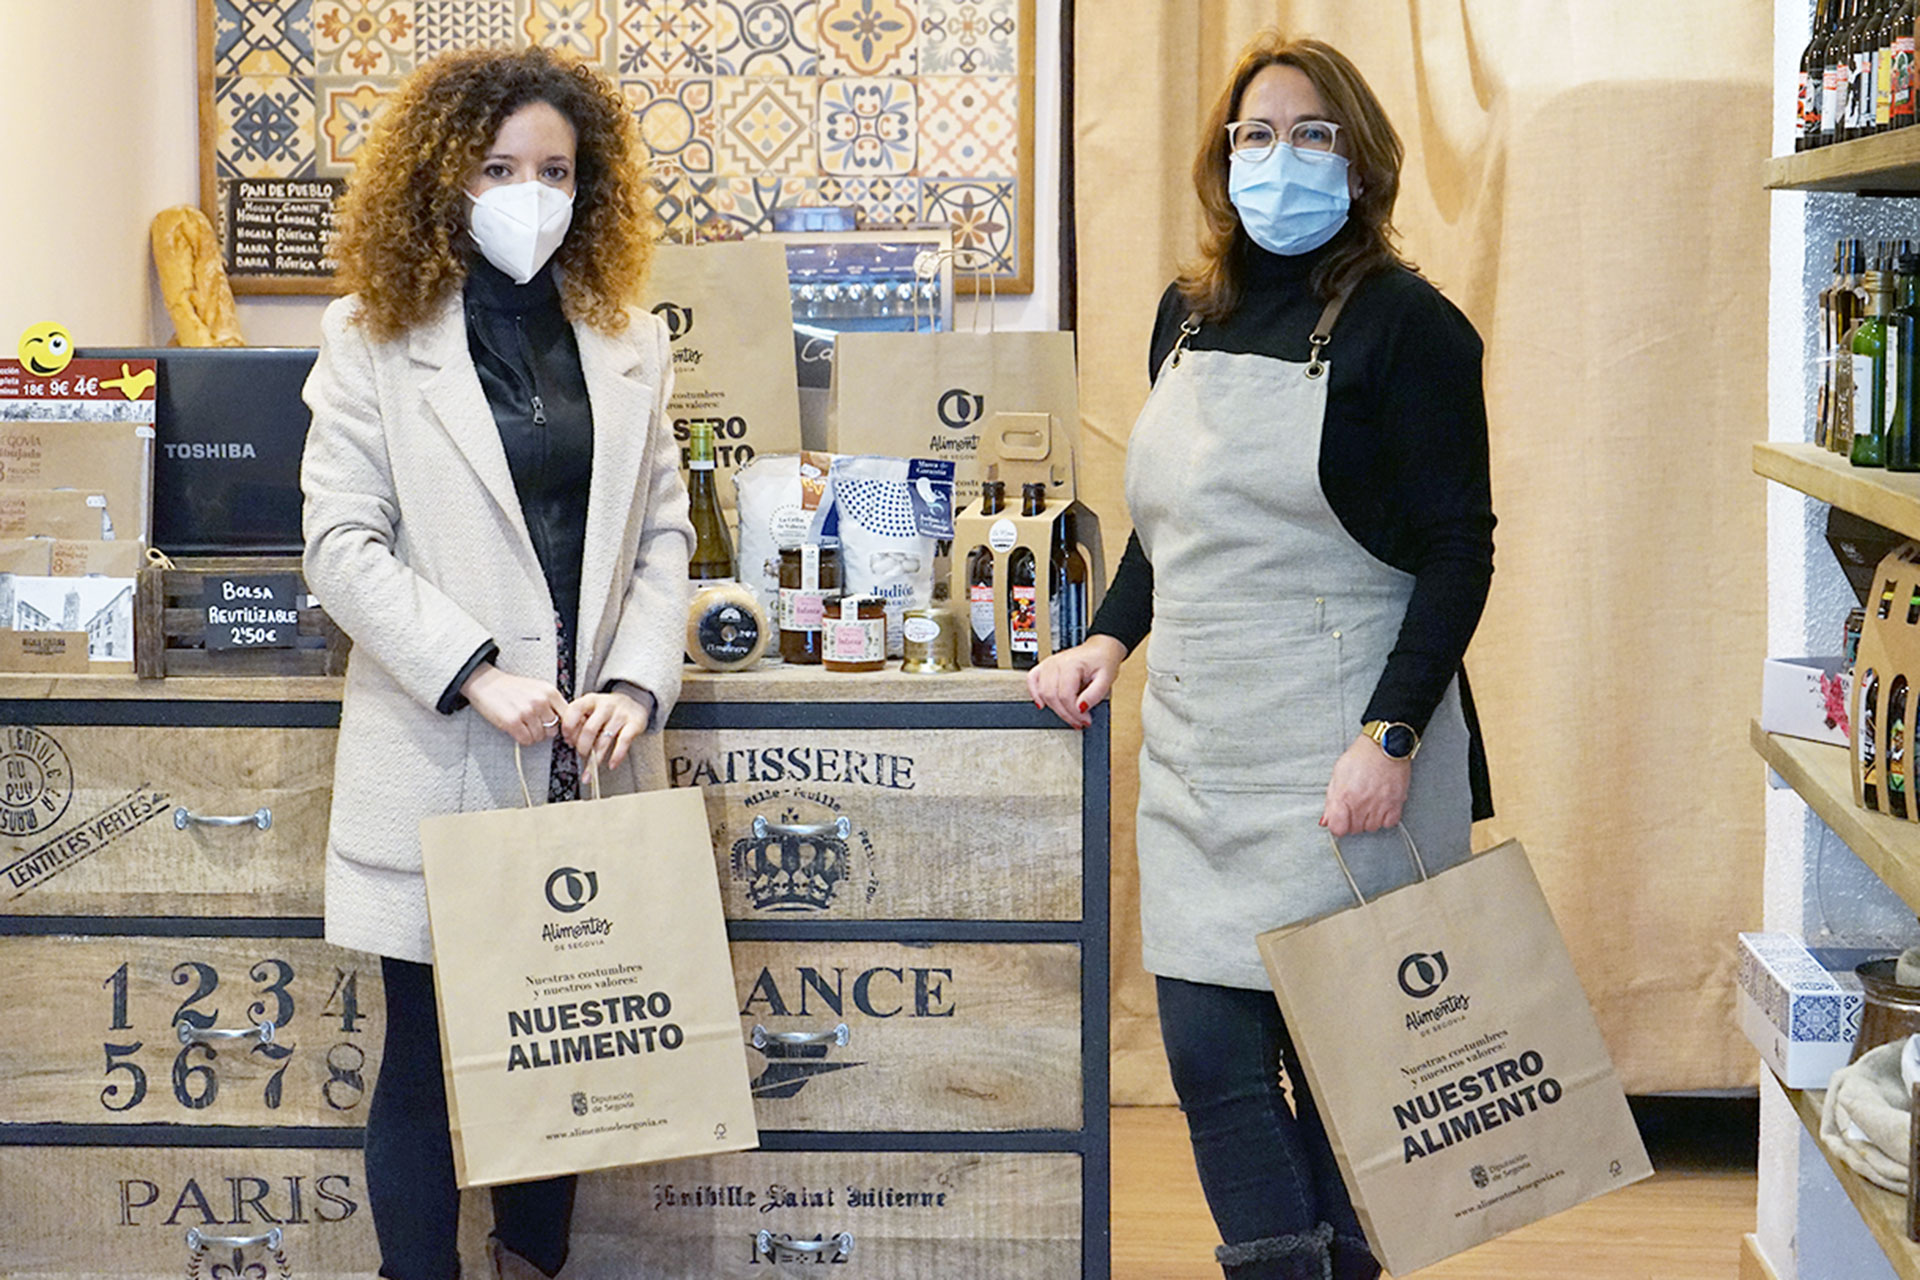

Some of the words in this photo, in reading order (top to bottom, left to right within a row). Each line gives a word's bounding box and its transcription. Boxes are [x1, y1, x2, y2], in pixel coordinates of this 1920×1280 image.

[240, 183, 266, 198] PAN
[269, 184, 285, 198] DE
[287, 183, 333, 198] PUEBLO
[23, 383, 45, 396] 18€
[50, 381, 70, 396] 9€
[74, 376, 98, 396] 4€
[164, 443, 256, 459] TOSHIBA
[222, 581, 274, 600] BOLSA
[669, 747, 916, 790] PATISSERIE
[6, 781, 33, 801] PUY
[8, 831, 91, 888] LENTILLES
[89, 795, 153, 841] VERTES
[542, 916, 613, 942] Alimentos
[554, 944, 565, 952] DE
[567, 939, 605, 950] SEGOVIA
[525, 970, 576, 986] Nuestras
[578, 963, 643, 981] costumbres
[543, 983, 592, 996] nuestros
[595, 975, 638, 989] valores:
[103, 961, 134, 1031] 1
[171, 961, 219, 1029] 2
[247, 958, 295, 1029] 3
[320, 964, 367, 1034] 4
[508, 991, 672, 1037] NUESTRO
[1405, 993, 1471, 1031] Alimentos
[507, 1023, 684, 1072] ALIMENTO
[1400, 1055, 1448, 1079] Nuestras
[1448, 1029, 1509, 1058] costumbres
[100, 1040, 147, 1112] 5
[172, 1041, 219, 1110] 6
[251, 1042, 297, 1110] 7
[322, 1041, 366, 1110] 8
[1393, 1050, 1544, 1131] NUESTRO
[1419, 1060, 1465, 1083] nuestros
[1402, 1078, 1562, 1165] ALIMENTO
[117, 1174, 359, 1227] PARIS
